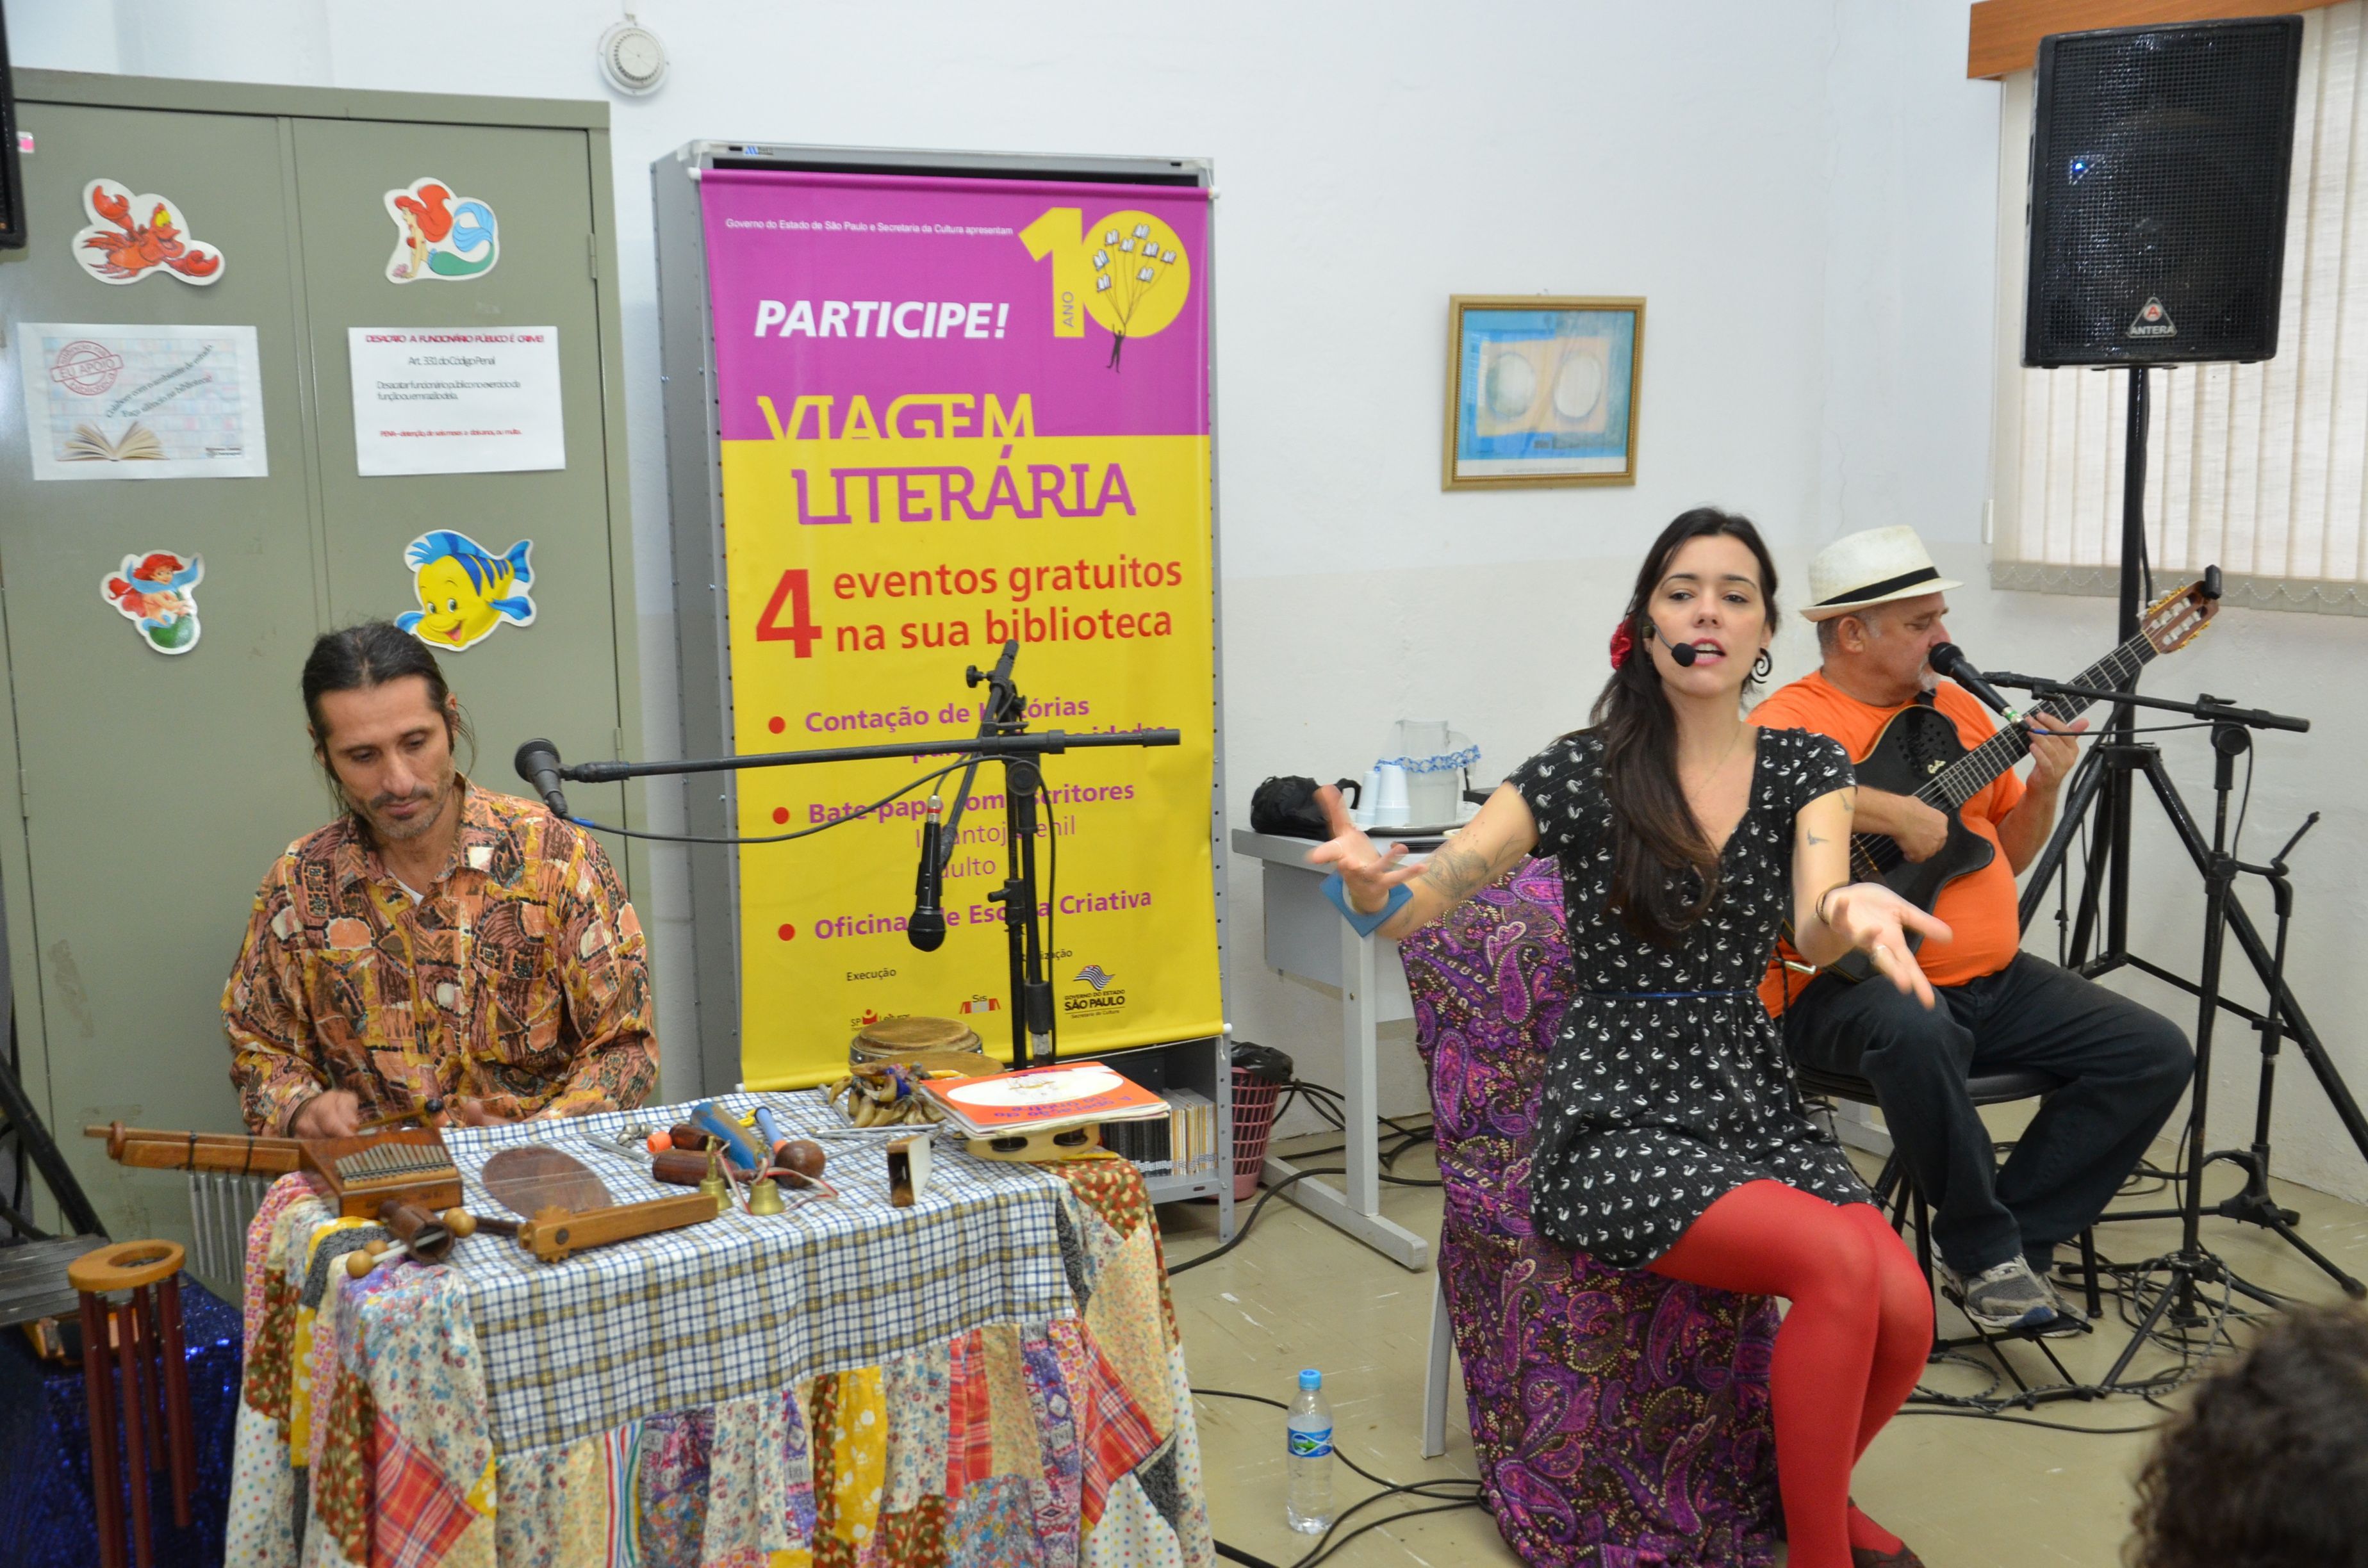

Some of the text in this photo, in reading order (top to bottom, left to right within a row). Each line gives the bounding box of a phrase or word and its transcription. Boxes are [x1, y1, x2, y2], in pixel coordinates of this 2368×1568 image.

[726, 218, 764, 228] Governo
[766, 220, 777, 228] do
[779, 220, 810, 229] Estado
[811, 220, 822, 229] de
[825, 220, 842, 230] São
[844, 221, 867, 231] Paulo
[877, 222, 919, 232] Secretaria
[921, 224, 932, 232] da
[934, 224, 964, 233] Cultura
[966, 226, 1013, 235] apresentam
[1018, 207, 1190, 338] 10
[754, 299, 1009, 338] PARTICIPE!
[1062, 291, 1074, 327] ANO
[2130, 325, 2175, 334] ANTERA
[60, 358, 115, 378] EU APOIO
[476, 355, 495, 365] Penal
[757, 393, 1035, 439] VIAGEM
[791, 444, 1136, 525] LITERÁRIA
[834, 554, 1182, 602] eventos gratuitos
[756, 569, 822, 658] 4
[836, 607, 1172, 652] na sua biblioteca
[805, 705, 929, 733] Contação
[939, 703, 970, 724] de
[809, 799, 943, 824] Bate-pap
[964, 793, 1005, 811] om
[940, 906, 960, 927] e
[969, 902, 1050, 924] Esca
[1060, 889, 1151, 915] Criativa
[846, 967, 897, 981] Execução
[1065, 996, 1125, 1011] SÃO PAULO
[851, 1018, 862, 1027] SP
